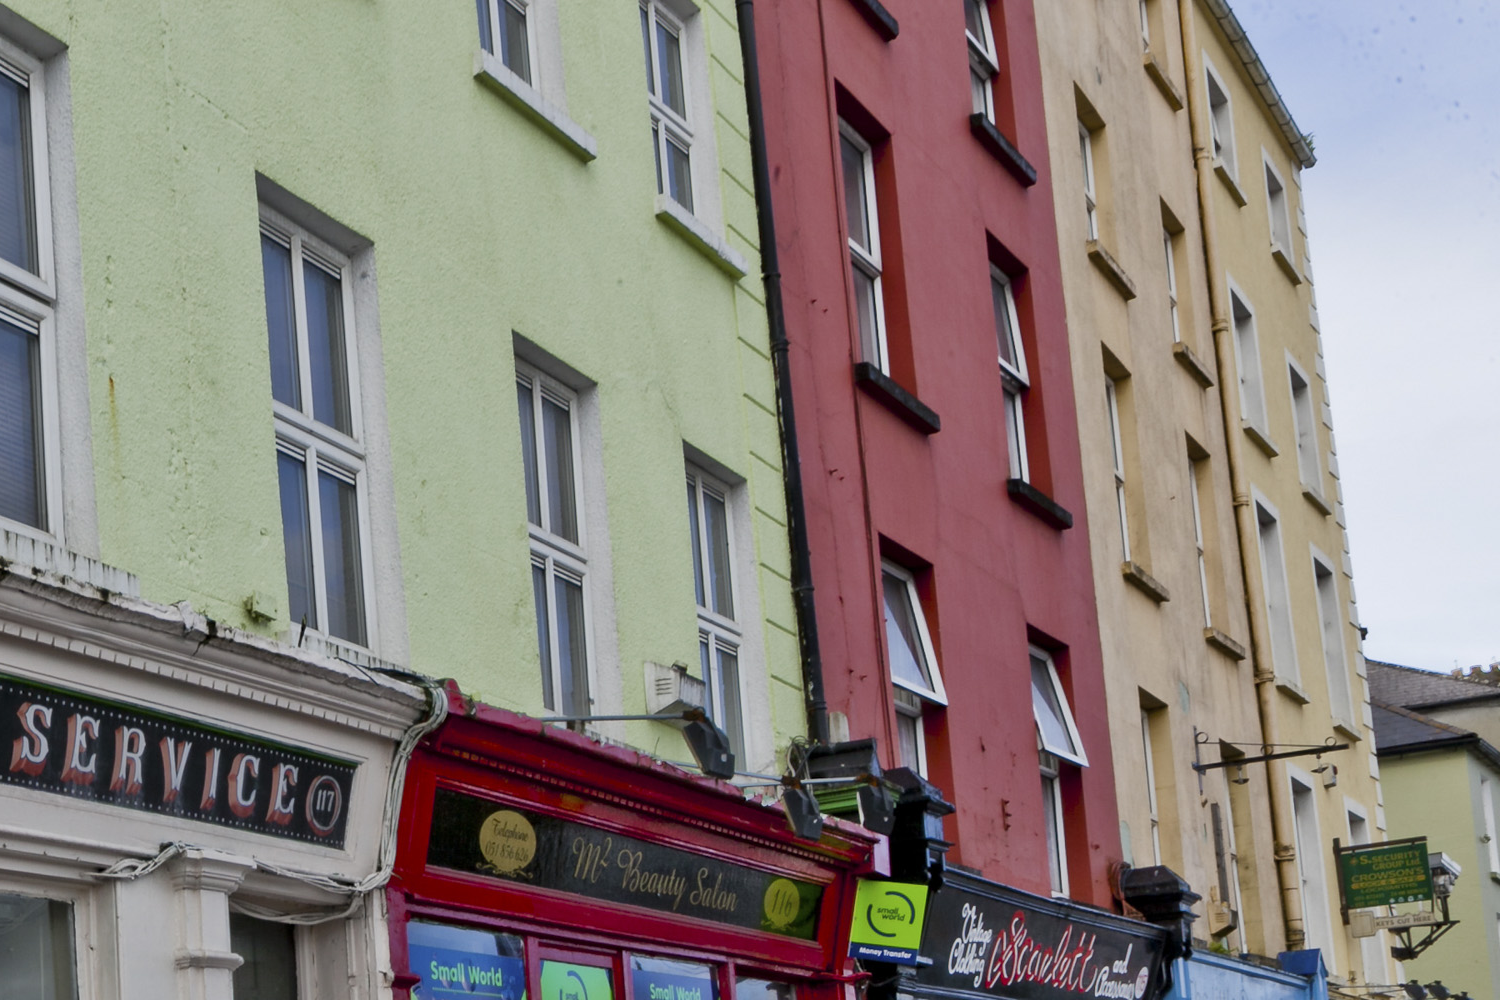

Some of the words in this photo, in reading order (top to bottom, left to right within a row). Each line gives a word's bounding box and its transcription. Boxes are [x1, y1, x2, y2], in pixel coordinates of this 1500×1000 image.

[10, 702, 298, 825] SERVICE
[314, 789, 336, 814] 117
[492, 818, 529, 841] Telephone
[1372, 850, 1420, 862] SECURITY
[618, 849, 687, 911] Beauty
[690, 867, 738, 912] Salon
[772, 888, 793, 917] 116
[877, 907, 899, 915] small
[1397, 917, 1411, 925] CUT
[1413, 915, 1431, 923] HERE
[859, 947, 882, 957] Money
[883, 949, 912, 959] Transfer
[948, 937, 985, 988] Clothing
[1113, 943, 1133, 974] and
[430, 961, 464, 982] Small
[468, 965, 503, 987] World
[566, 991, 578, 1000] small
[650, 983, 673, 1000] Small
